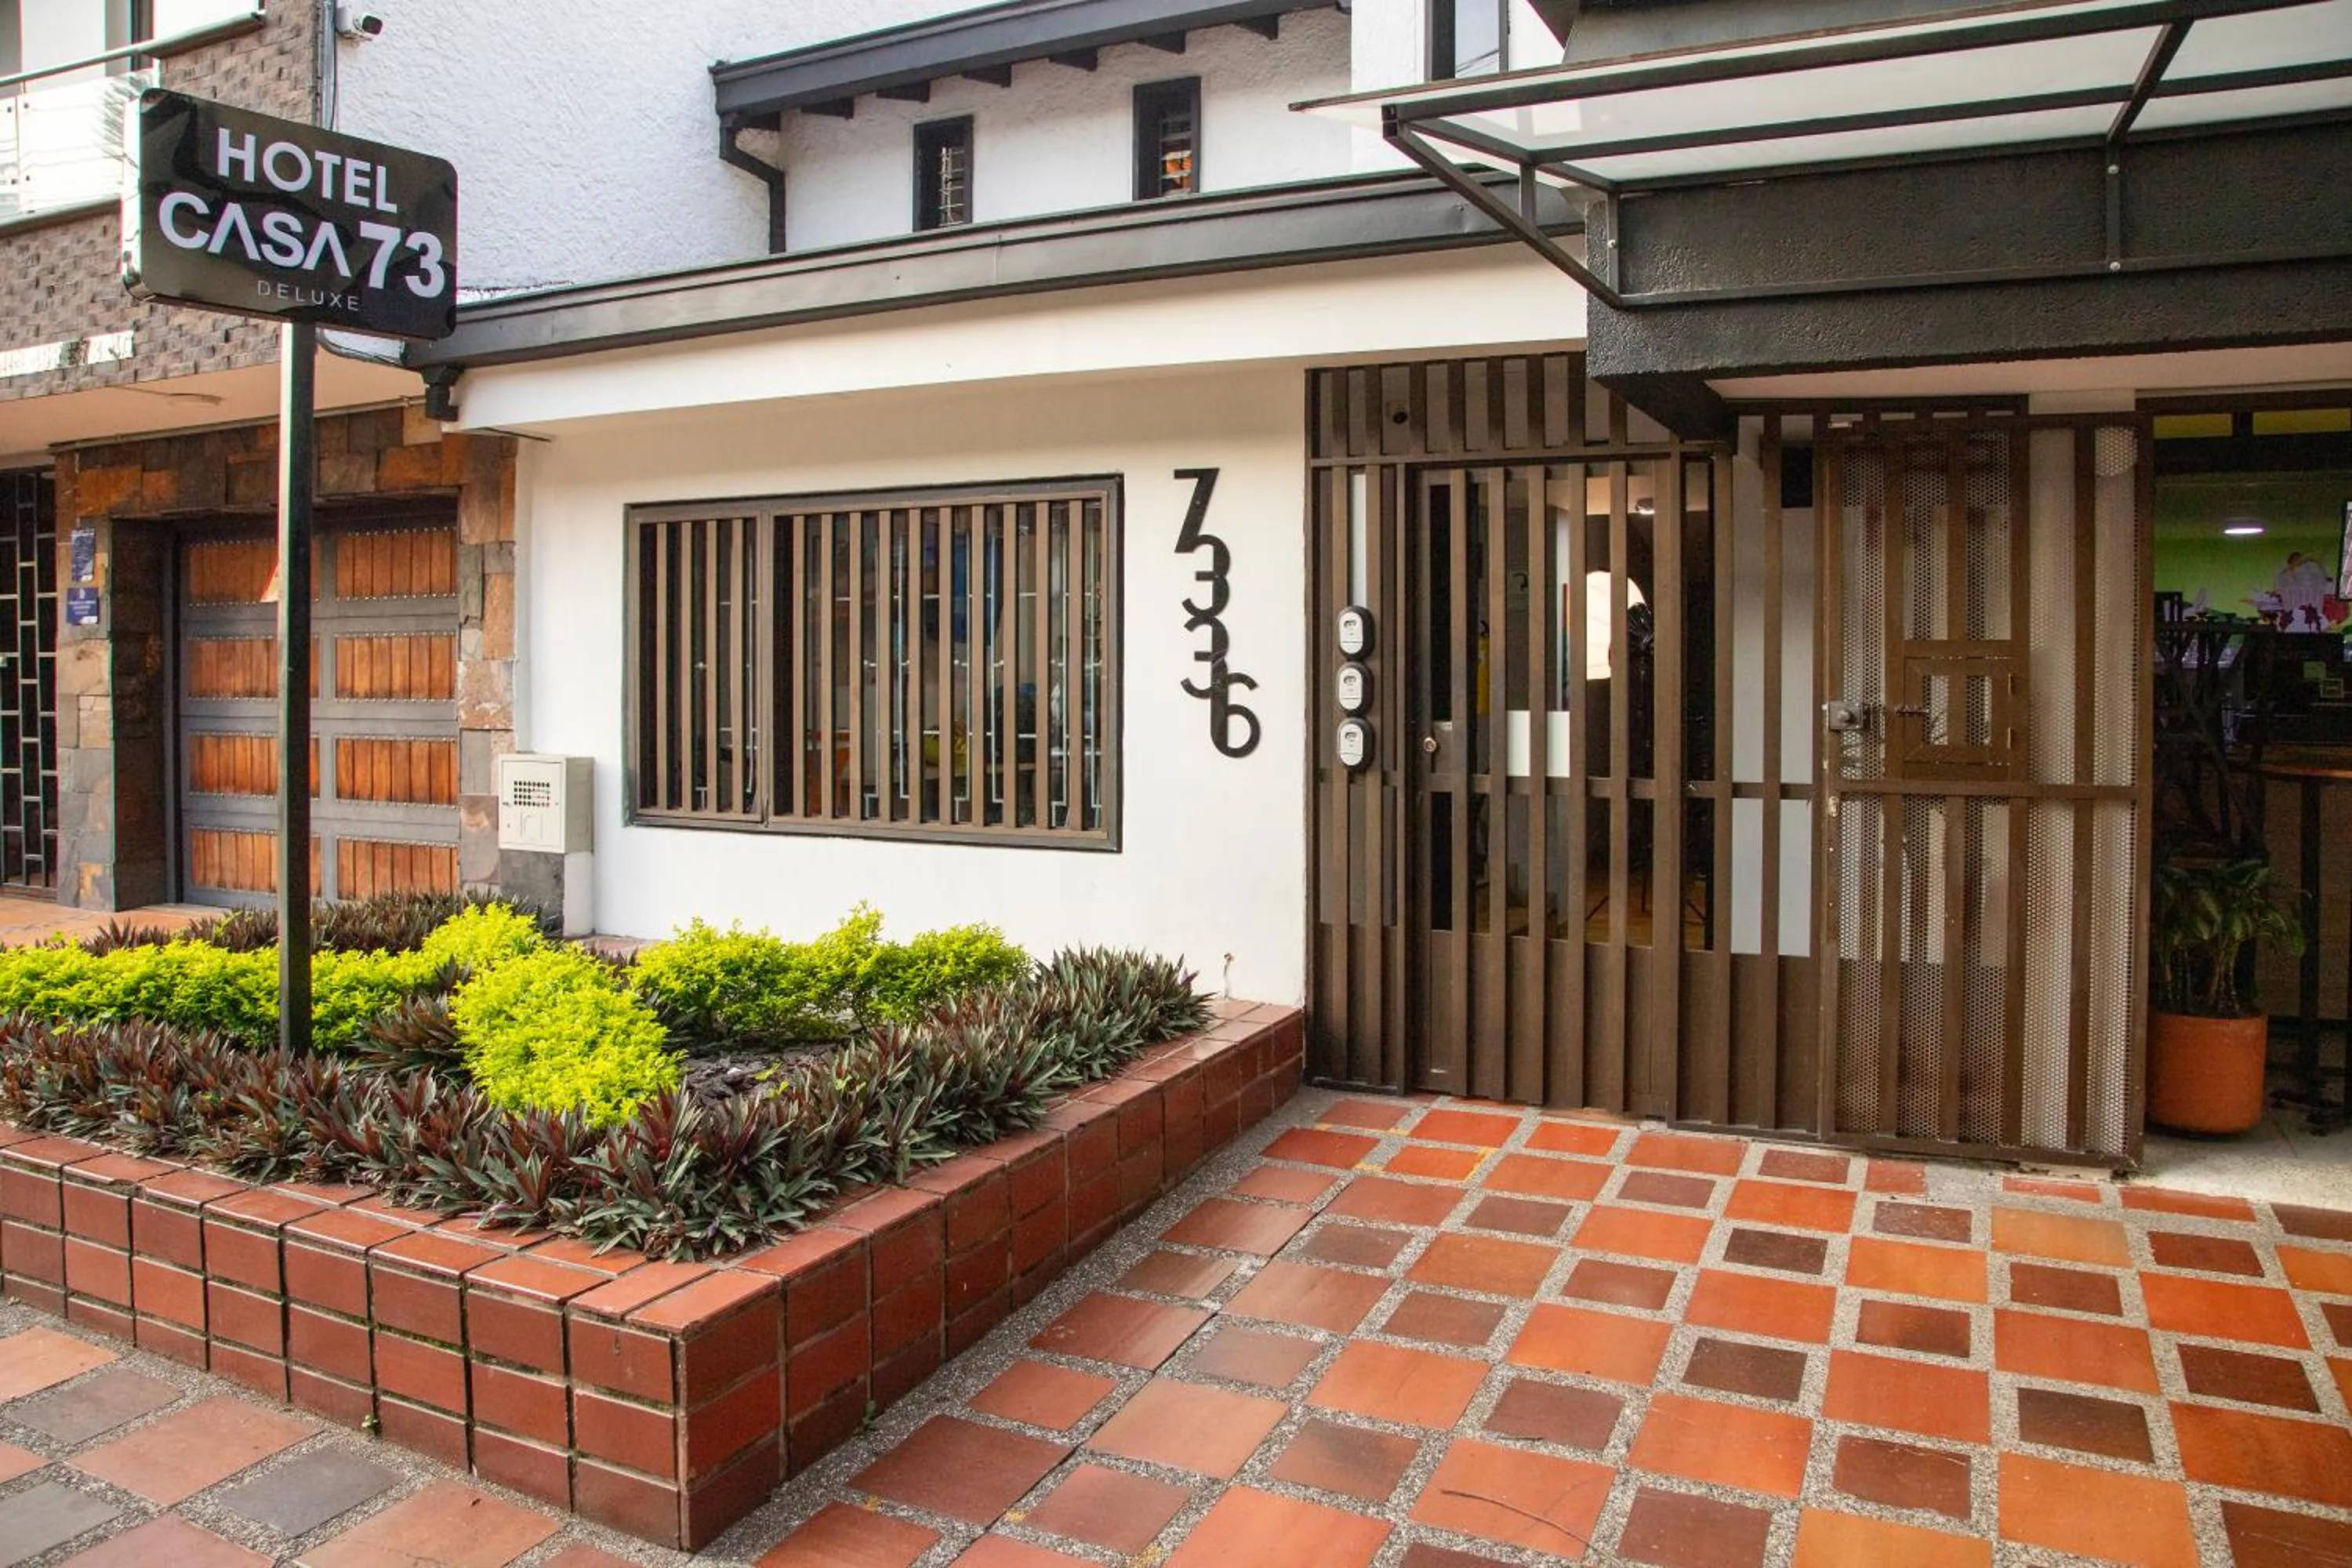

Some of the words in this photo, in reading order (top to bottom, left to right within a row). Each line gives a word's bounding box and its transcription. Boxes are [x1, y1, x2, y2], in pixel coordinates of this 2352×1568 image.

[216, 127, 398, 214] HOTEL
[158, 191, 352, 278] CASA
[359, 220, 446, 299] 73
[257, 280, 361, 311] DELUXE
[1174, 467, 1261, 759] 7336
